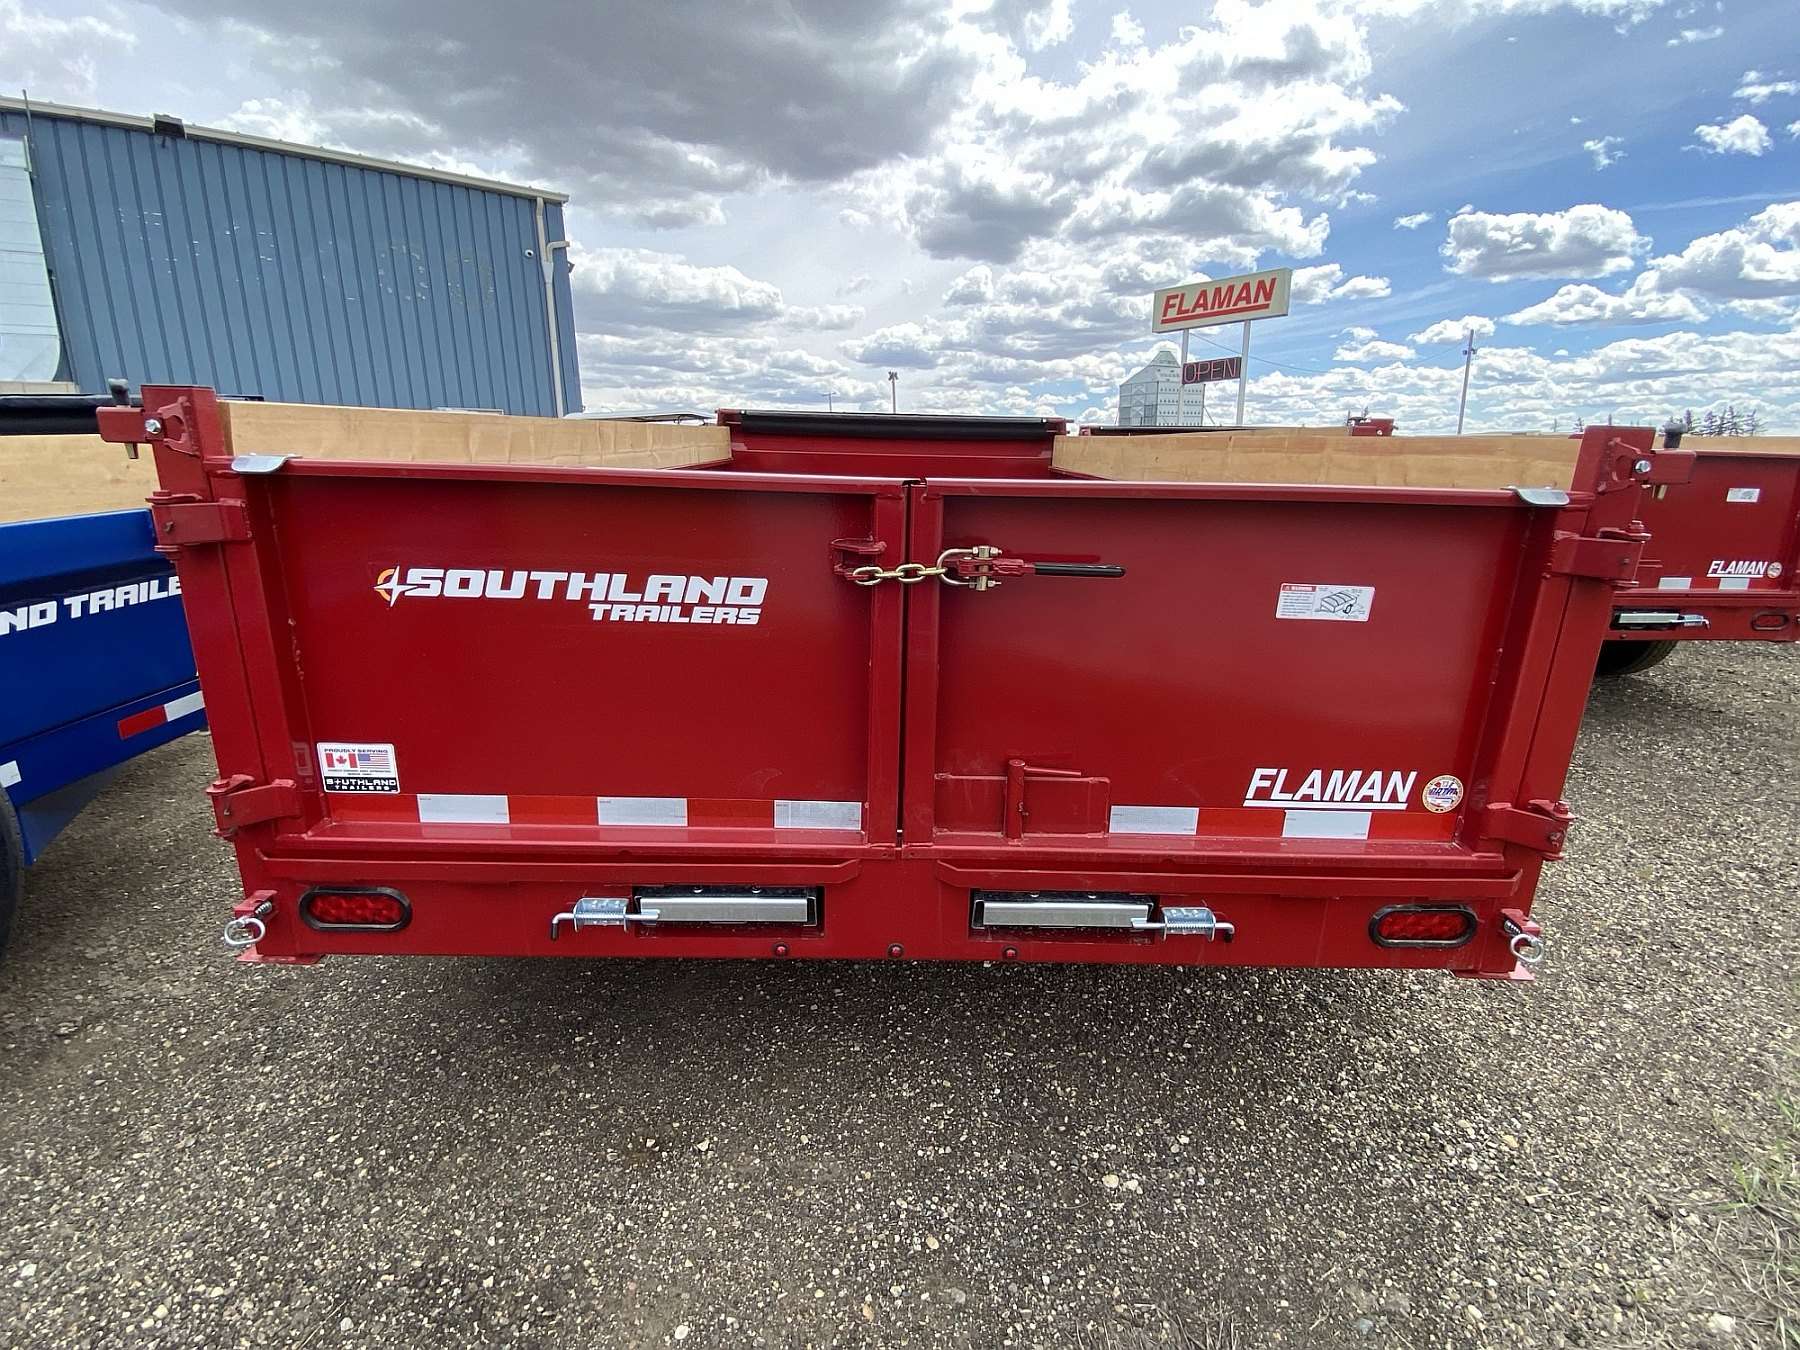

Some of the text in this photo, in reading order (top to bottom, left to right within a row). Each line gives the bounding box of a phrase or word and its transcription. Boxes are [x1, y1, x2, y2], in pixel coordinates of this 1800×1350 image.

[1162, 277, 1277, 318] FLAMAN
[1183, 358, 1237, 383] OPEN
[1708, 560, 1768, 574] FLAMAN
[404, 568, 768, 605] SOUTHLAND
[588, 603, 761, 625] TRAILERS
[1245, 767, 1418, 803] FLAMAN
